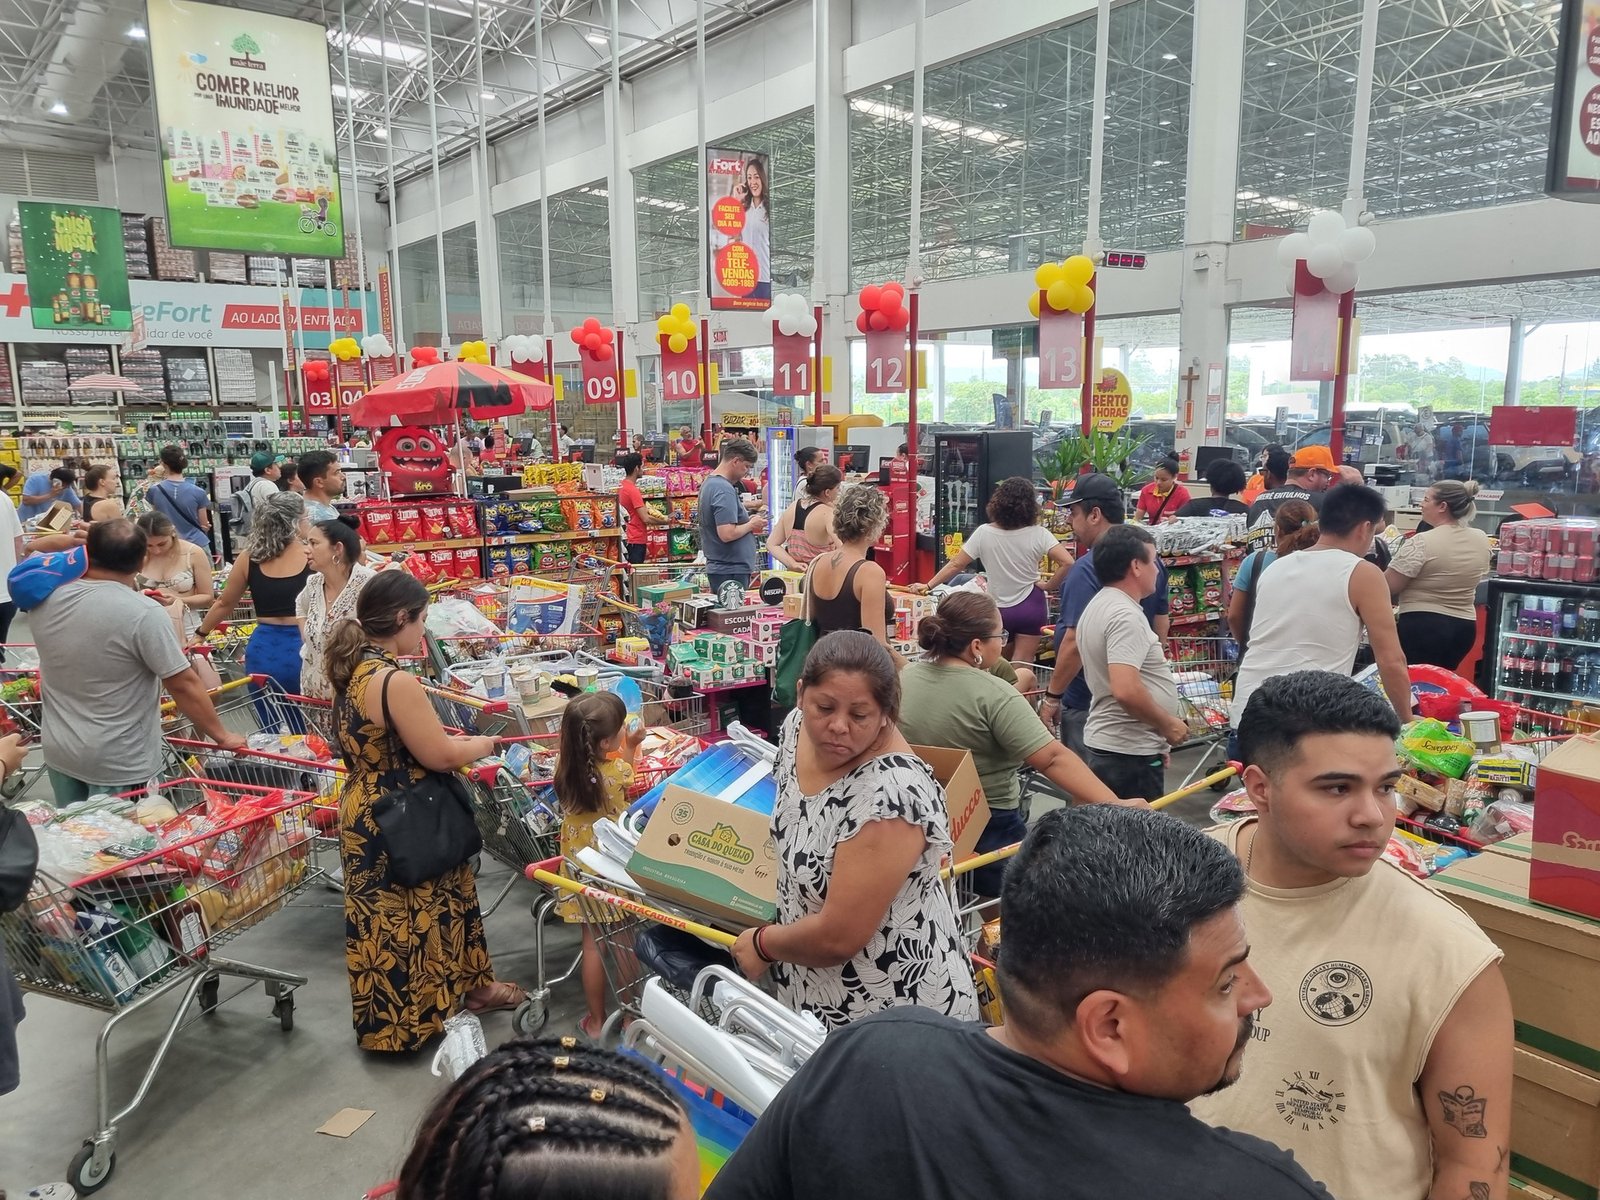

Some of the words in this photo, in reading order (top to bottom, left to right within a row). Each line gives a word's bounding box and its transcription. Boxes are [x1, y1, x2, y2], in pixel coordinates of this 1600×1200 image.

[196, 72, 250, 96] COMER
[254, 80, 300, 102] MELHOR
[216, 92, 280, 115] IMUNIDADE
[280, 102, 301, 112] MELHOR
[712, 158, 741, 172] Fort
[718, 205, 740, 214] FACILITE
[54, 214, 93, 234] COISA
[54, 232, 98, 254] NOSSA
[728, 258, 750, 270] TELE-
[722, 268, 754, 279] VENDAS
[230, 312, 248, 324] AO
[251, 313, 280, 324] LADO
[172, 329, 184, 339] de
[188, 330, 213, 340] você
[1045, 346, 1077, 382] 13
[778, 362, 808, 391] 11
[870, 356, 902, 388] 12
[587, 376, 616, 400] 09
[666, 370, 696, 395] 10
[310, 392, 331, 406] 03
[342, 390, 363, 405] 04
[724, 415, 746, 425] BAZAR
[1097, 408, 1128, 418] HORAS
[881, 460, 892, 468] For
[1274, 491, 1310, 500] ENTULHOS
[724, 615, 756, 624] ESCOLHA
[676, 808, 689, 818] 35
[951, 788, 981, 842] ducco
[691, 834, 711, 850] CASA
[711, 842, 722, 852] DO
[723, 844, 751, 862] QUEIJO
[625, 903, 687, 929] ATACADISTA
[1352, 966, 1370, 990] RESEARCH
[1251, 1025, 1271, 1042] OUP
[1309, 1071, 1320, 1080] XII
[1290, 1098, 1310, 1106] UNITED
[1291, 1111, 1324, 1120] PHENOMENA
